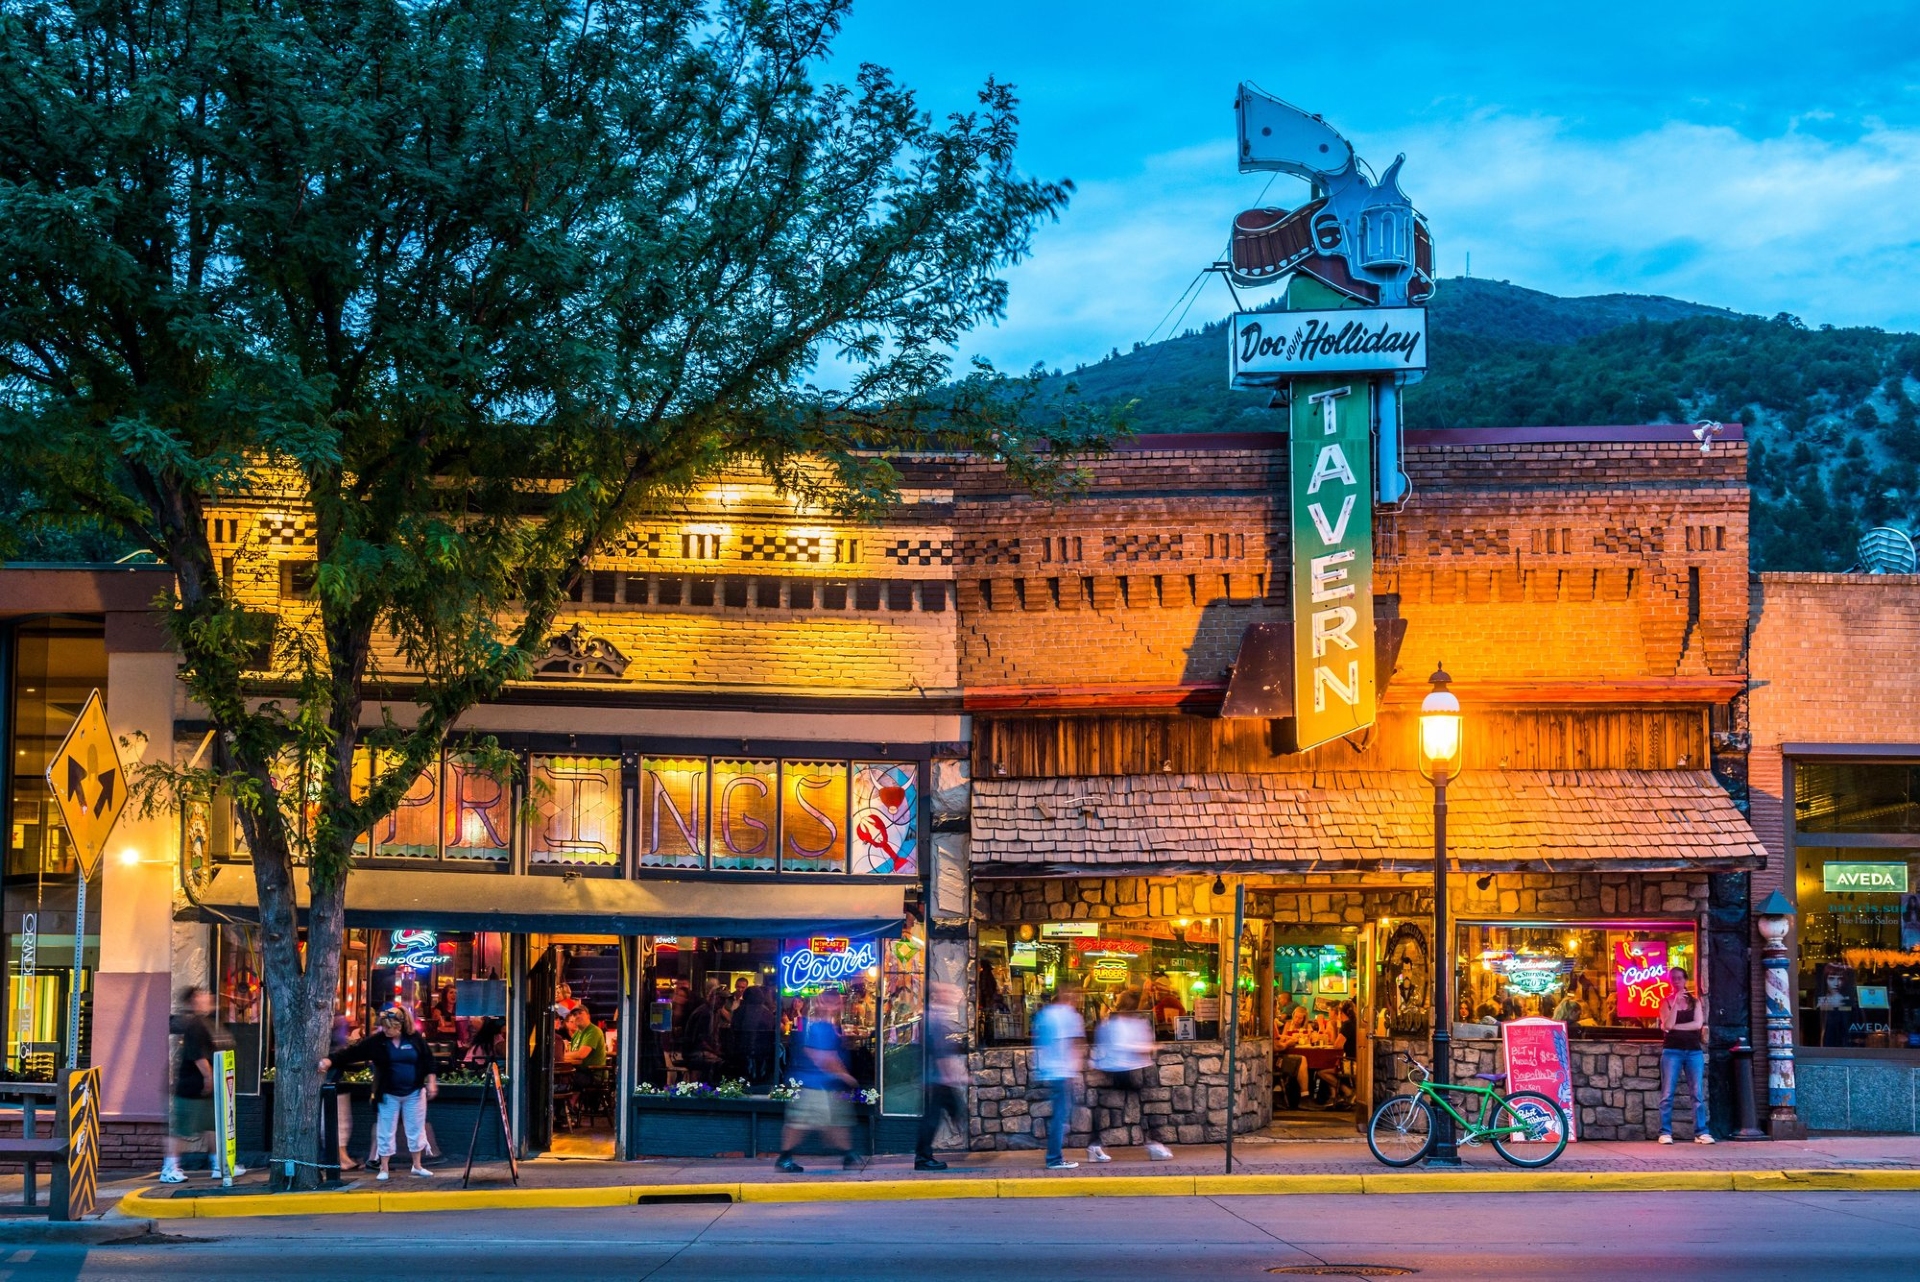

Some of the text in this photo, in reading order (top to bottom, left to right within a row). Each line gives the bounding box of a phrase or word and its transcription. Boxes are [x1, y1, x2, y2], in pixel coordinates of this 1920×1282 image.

[1240, 319, 1421, 363] Doc JOHN Holliday
[1307, 385, 1360, 713] TAVERN
[1836, 872, 1896, 886] AVEDA
[1838, 914, 1899, 925] The Hair Salon
[1074, 936, 1149, 953] Budweiser
[376, 956, 451, 965] BUD LIGHT
[1502, 958, 1562, 970] Budweiser
[781, 943, 876, 991] Coors
[1093, 968, 1128, 978] BURGERS
[1621, 964, 1667, 986] Coors
[1849, 1022, 1891, 1032] AVEDA
[1511, 1046, 1528, 1056] BLT
[1514, 1083, 1541, 1093] Chicken
[1516, 1108, 1537, 1119] Pabst
